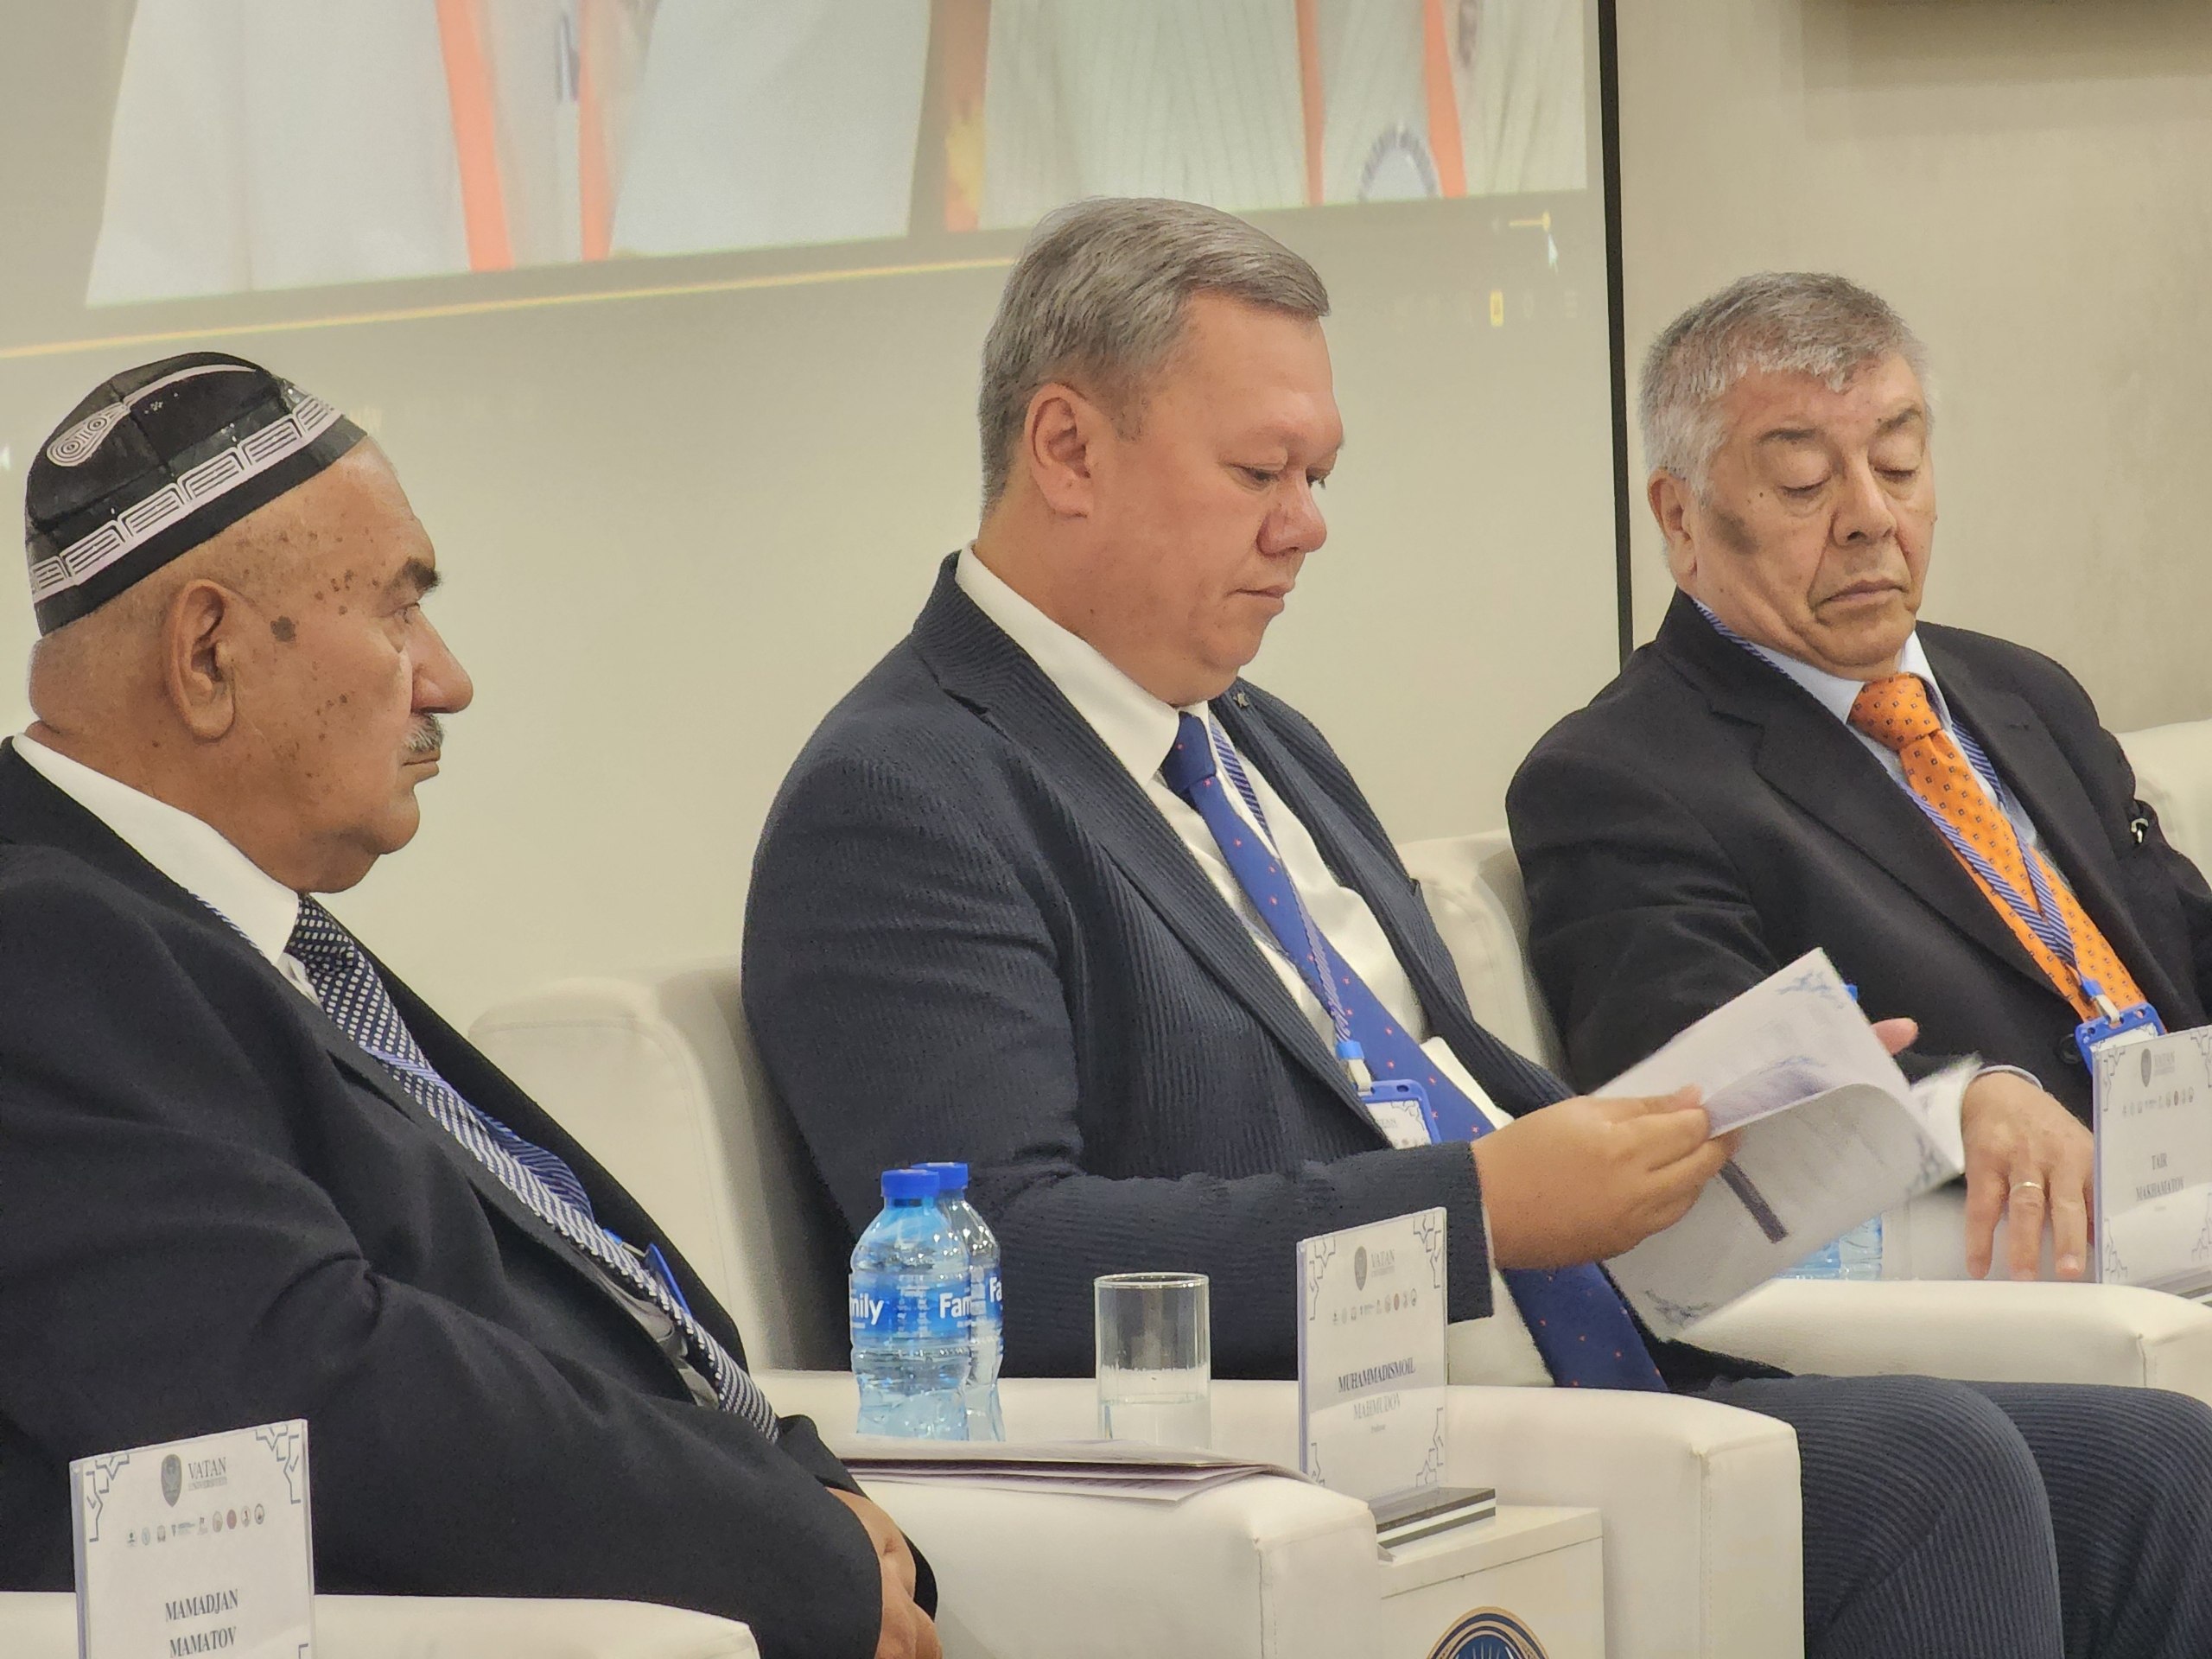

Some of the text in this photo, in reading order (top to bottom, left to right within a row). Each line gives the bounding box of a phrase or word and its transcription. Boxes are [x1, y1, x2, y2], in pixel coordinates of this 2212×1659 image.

[188, 1457, 227, 1479] VATAN
[165, 1588, 238, 1623] MAMADJAN
[169, 1626, 237, 1658] MAMATOV
